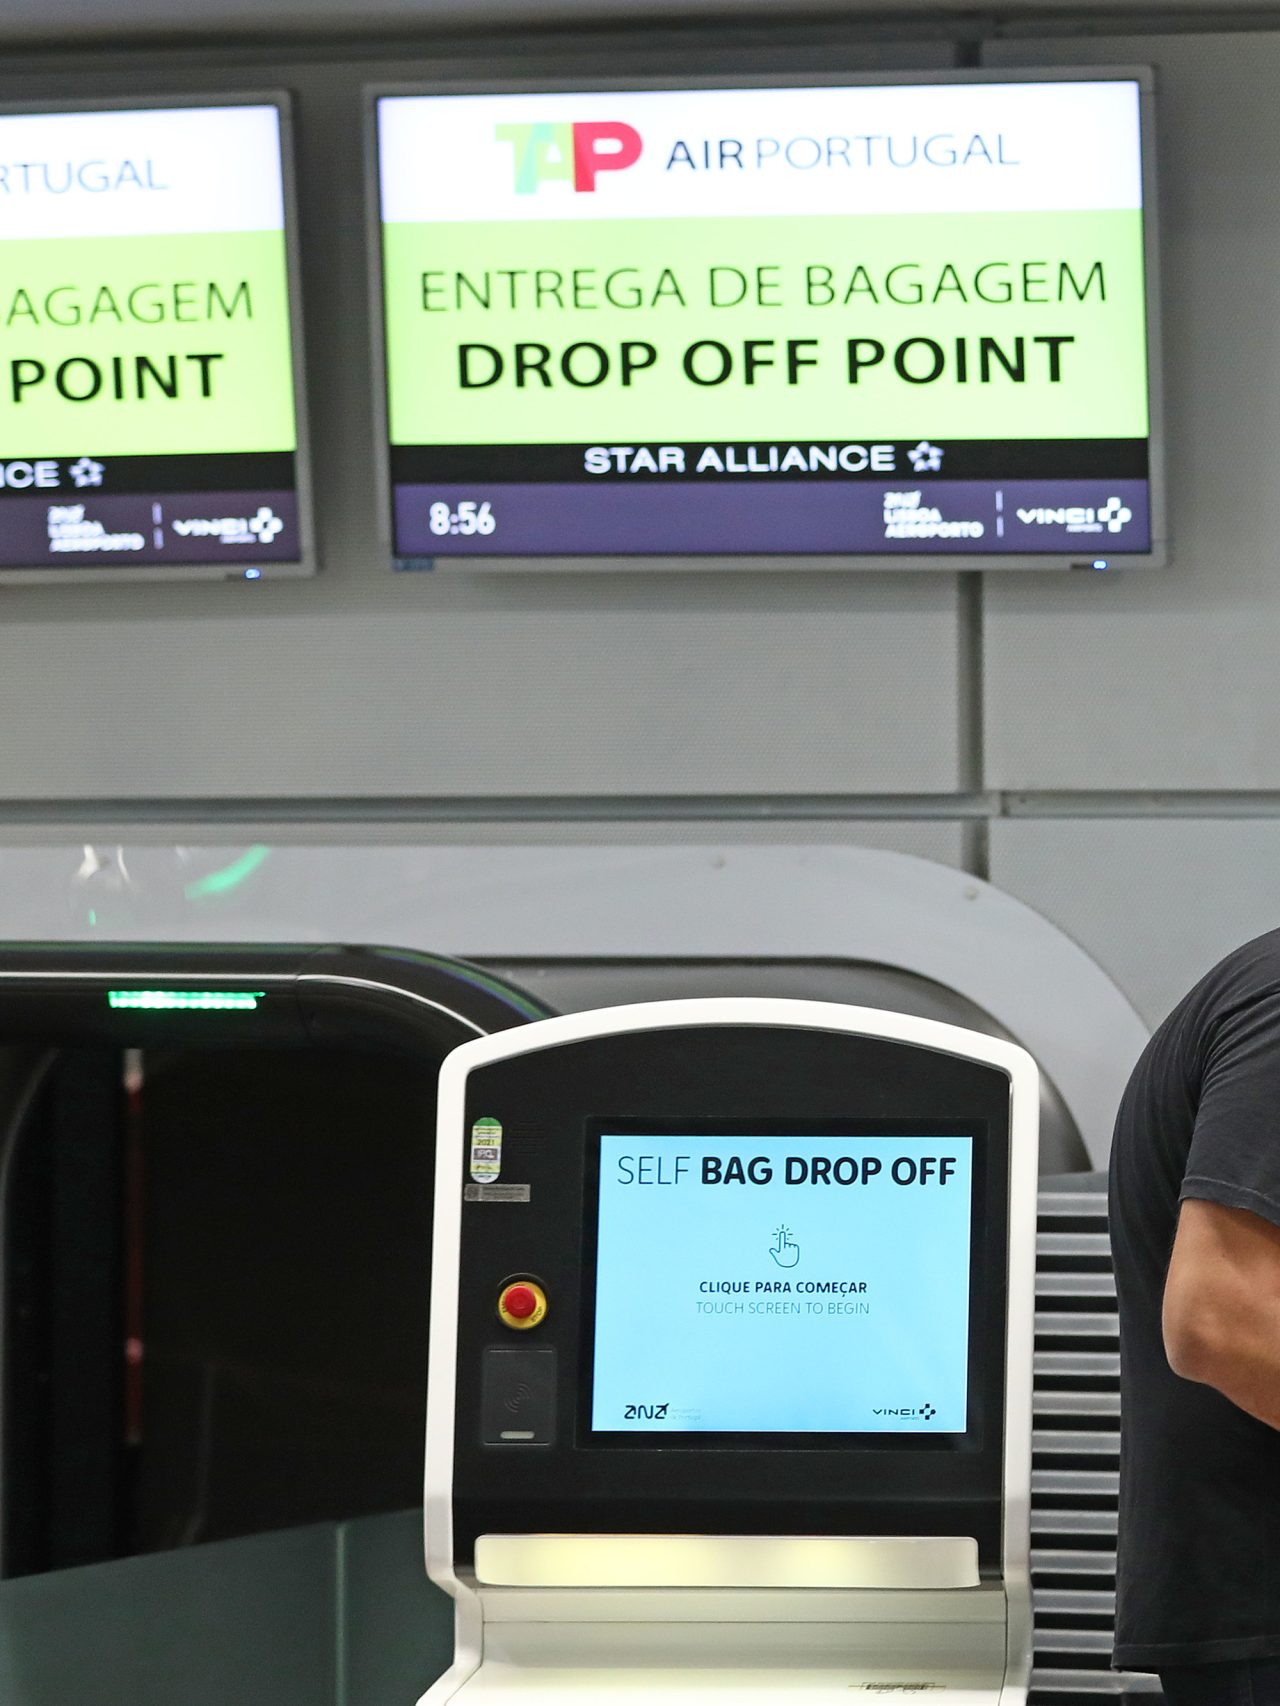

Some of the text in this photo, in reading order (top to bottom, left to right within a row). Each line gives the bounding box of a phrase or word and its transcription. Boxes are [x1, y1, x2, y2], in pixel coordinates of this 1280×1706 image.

[495, 121, 643, 195] TAP
[421, 260, 1106, 312] ENTREGA DE BAGAGEM
[6, 281, 254, 327] AGAGEM
[9, 352, 225, 403] POINT
[458, 335, 1075, 389] DROP OFF POINT
[0, 461, 61, 488] CE
[584, 444, 896, 474] STAR ALLIANCE
[429, 501, 496, 536] 8:56
[1016, 507, 1095, 525] VINCI
[617, 1155, 957, 1186] SELF BAG DROP OFF
[699, 1280, 868, 1298] CLIQUE PARA COMEÇAR
[696, 1301, 870, 1315] TOUCH SCREEN TO BEGIN
[872, 1408, 915, 1416] VINCI
